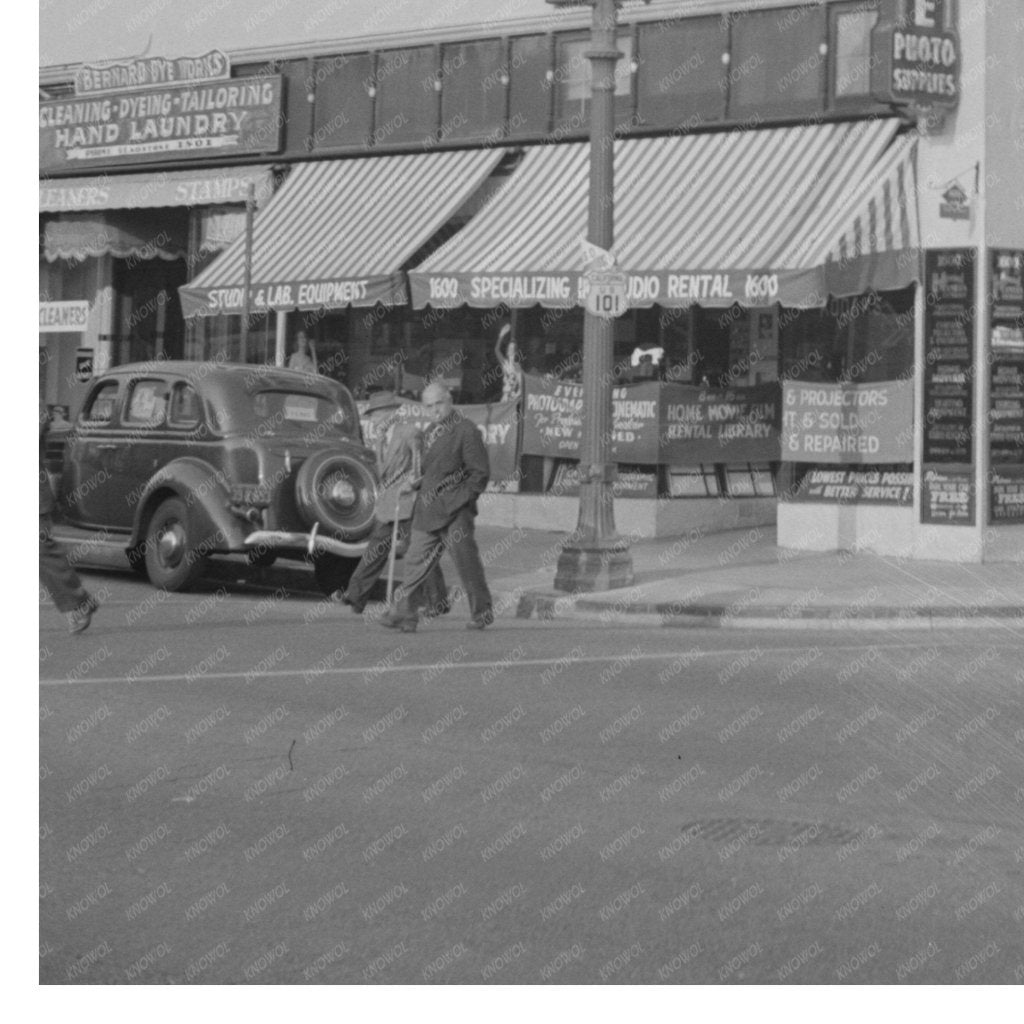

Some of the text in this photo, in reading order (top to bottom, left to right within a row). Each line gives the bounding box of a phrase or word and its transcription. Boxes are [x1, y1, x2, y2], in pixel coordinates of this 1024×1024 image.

[893, 32, 956, 67] PHOTO
[83, 61, 146, 91] BERNARD
[150, 59, 175, 80] DYE
[54, 110, 248, 148] HAND LAUNDRY
[39, 186, 112, 207] LEANERS
[208, 280, 369, 308] STUDI & LAB. EQUIPMENT
[429, 277, 459, 299] 1600
[470, 276, 570, 300] SPECIALIZING
[668, 274, 733, 299] RENTAL
[744, 273, 779, 298] 1600
[596, 294, 619, 312] 101
[800, 389, 888, 407] PROJECTORS
[667, 404, 703, 421] HOME
[708, 403, 746, 421] MOVIE
[819, 411, 858, 429] SOLD
[667, 423, 773, 439] RENTAL LIBRARY
[804, 434, 880, 453] REPAIRED
